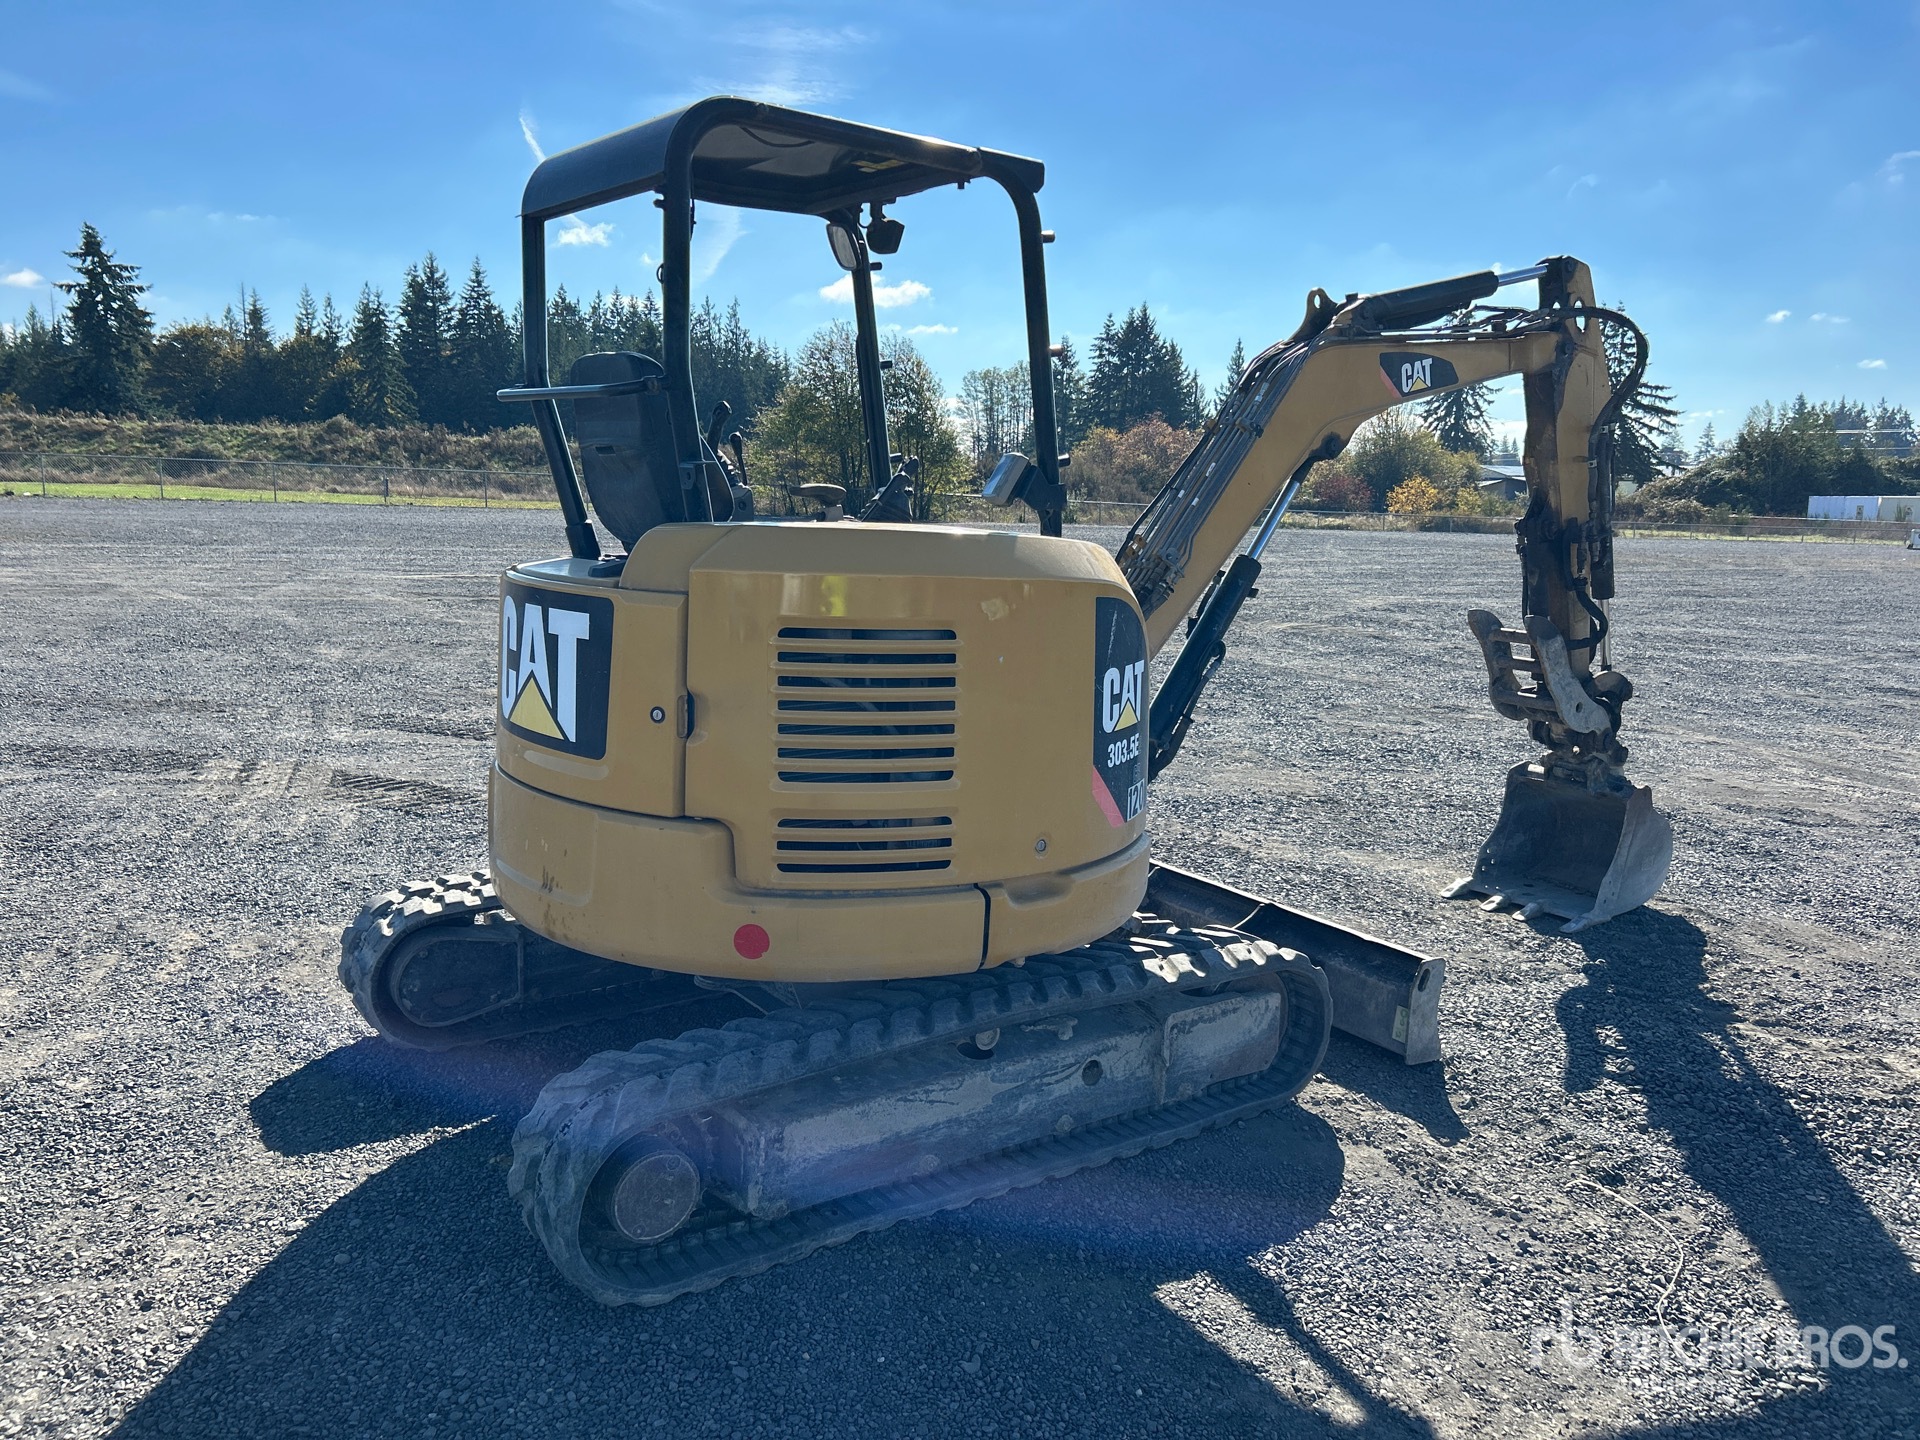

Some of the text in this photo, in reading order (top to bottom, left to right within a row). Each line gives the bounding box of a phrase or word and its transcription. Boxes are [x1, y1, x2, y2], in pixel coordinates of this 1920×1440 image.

[1401, 358, 1433, 393] CAT
[502, 595, 589, 743] CAT
[1102, 659, 1145, 734] CAT
[1107, 733, 1140, 768] 303.5E
